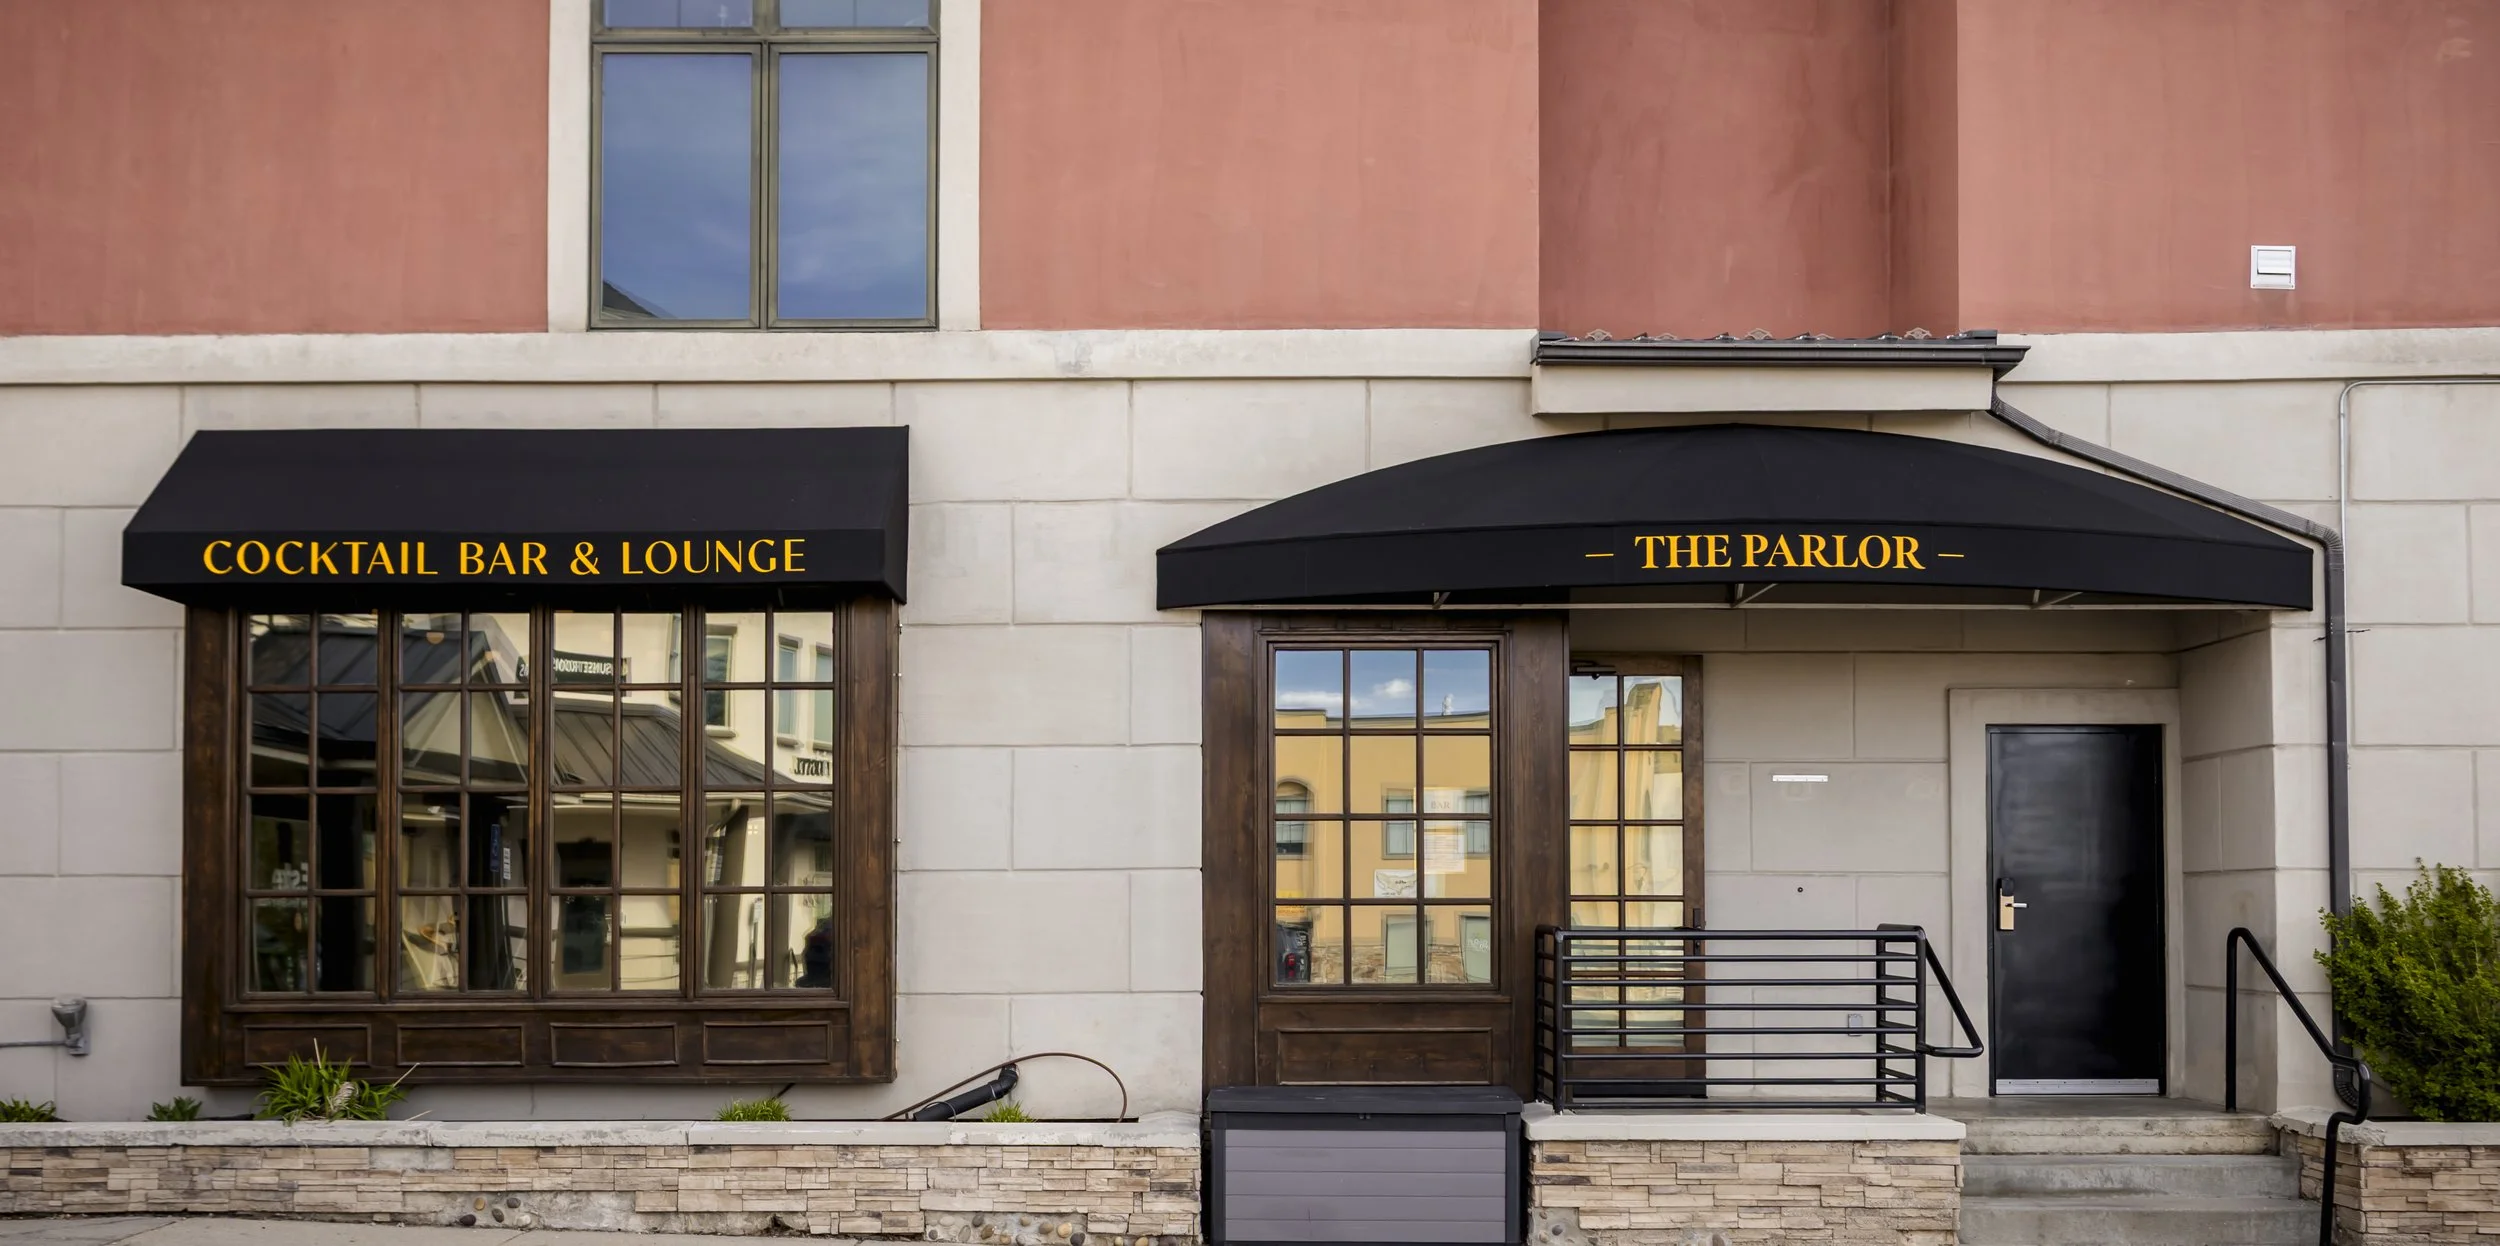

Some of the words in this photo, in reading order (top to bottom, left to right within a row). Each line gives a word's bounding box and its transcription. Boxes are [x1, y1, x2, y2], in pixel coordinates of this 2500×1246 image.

[203, 540, 438, 575] COCKTAIL
[460, 541, 548, 575] BAR
[570, 541, 601, 576] &
[623, 538, 806, 574] LOUNGE
[1634, 535, 1732, 569] THE
[1741, 534, 1926, 570] PARLOR
